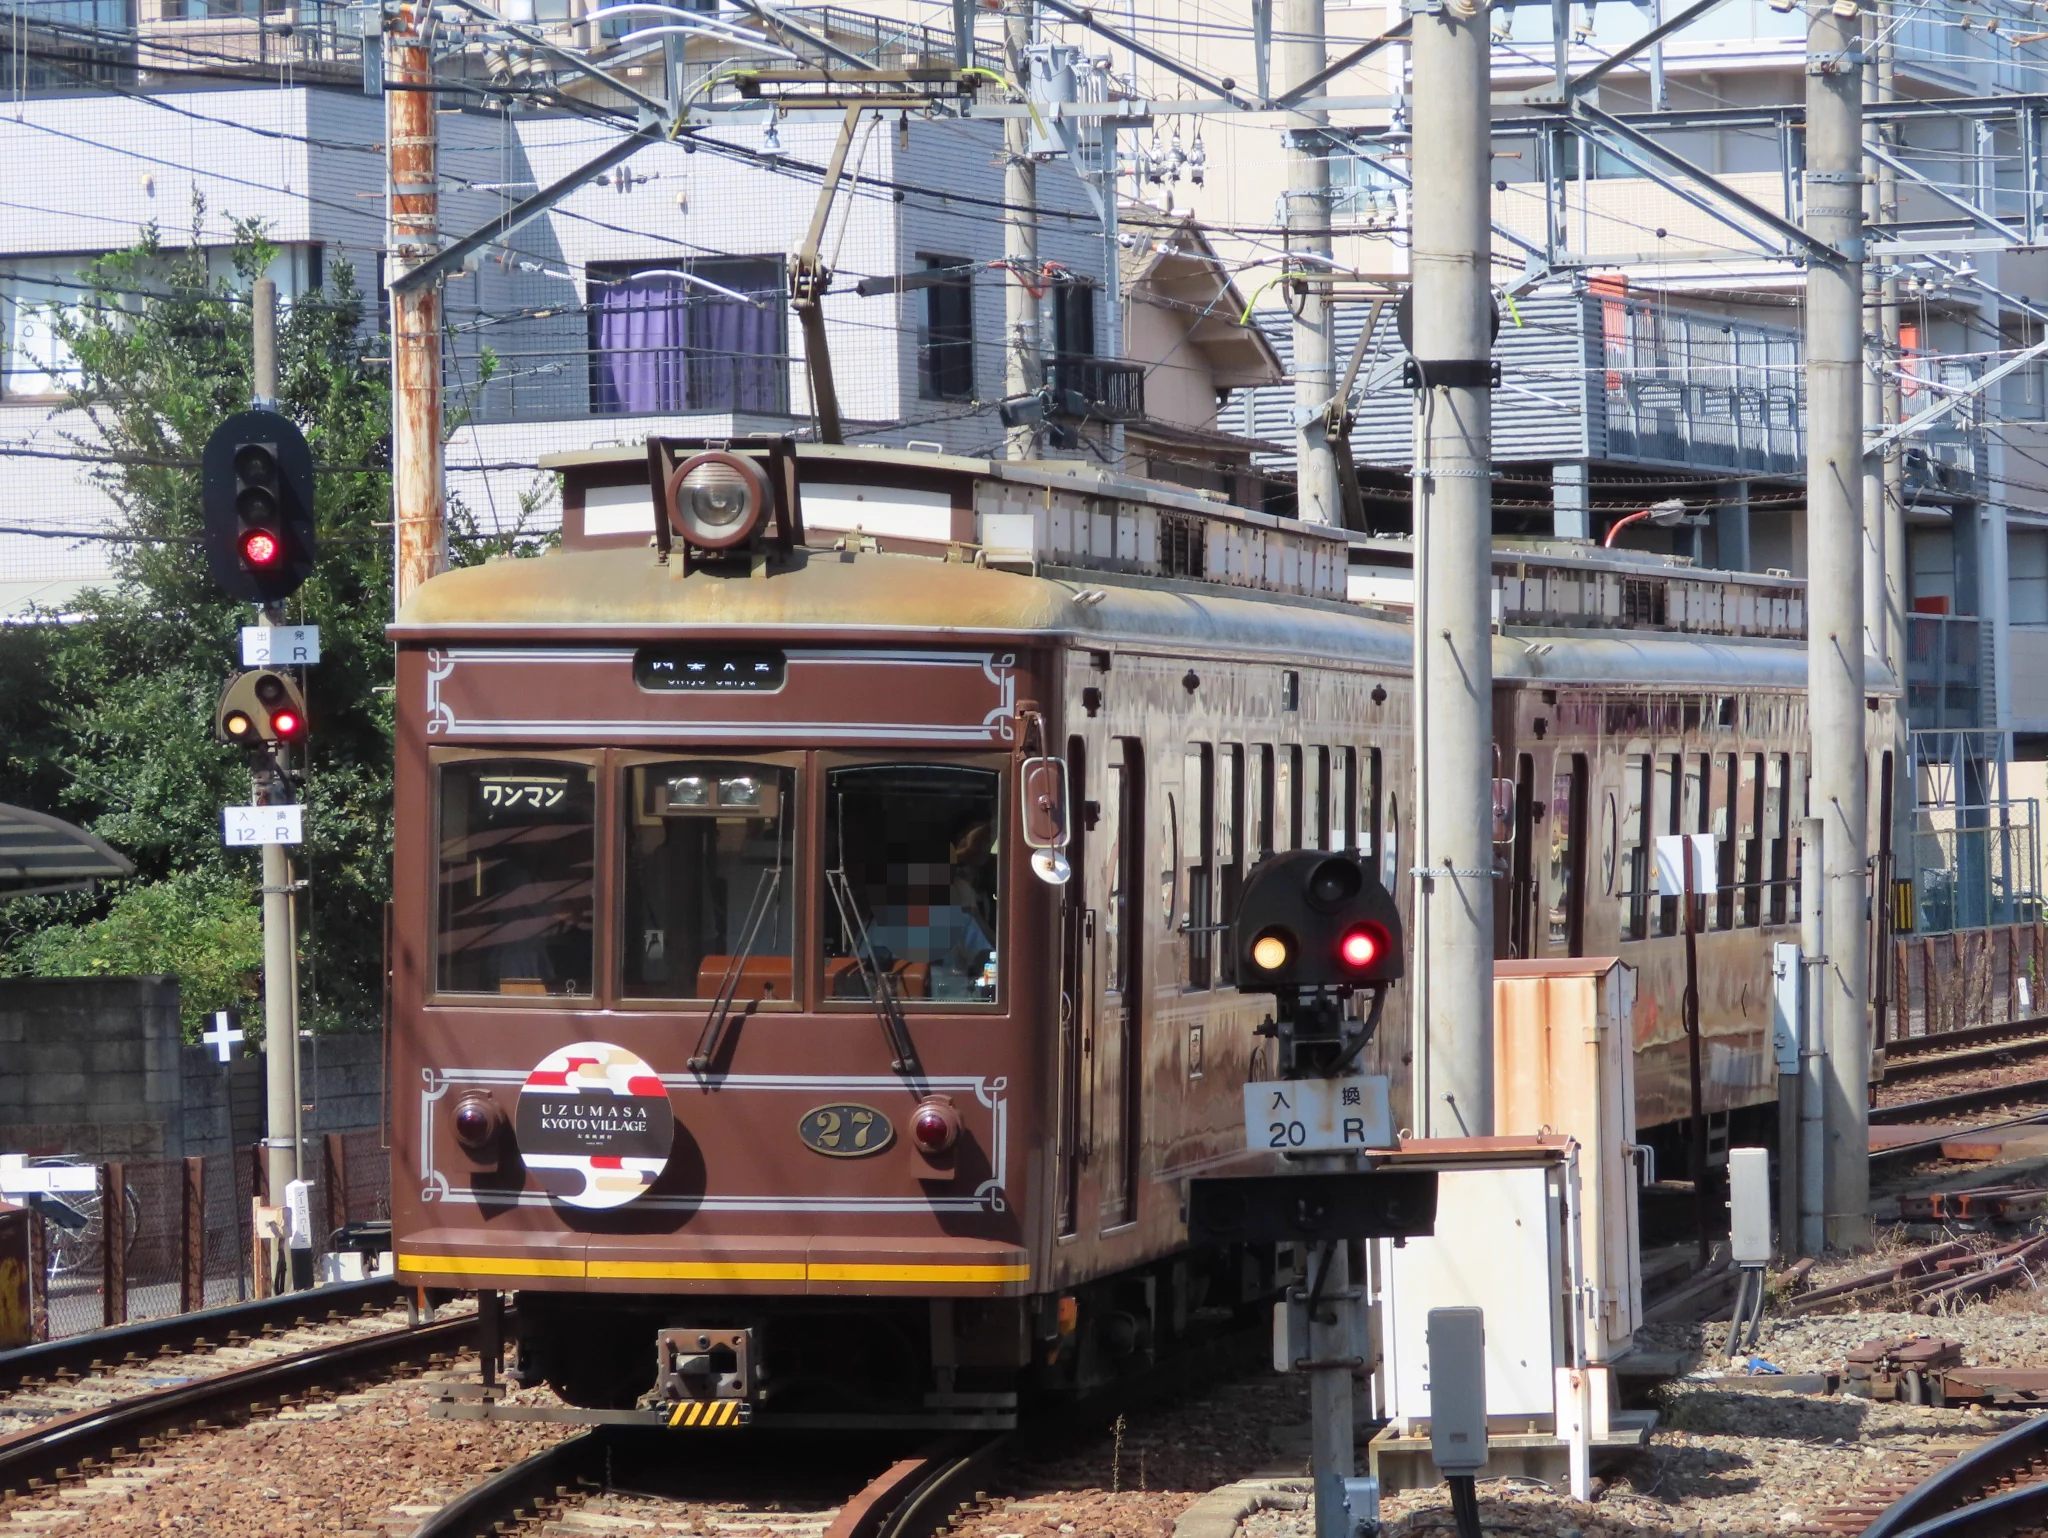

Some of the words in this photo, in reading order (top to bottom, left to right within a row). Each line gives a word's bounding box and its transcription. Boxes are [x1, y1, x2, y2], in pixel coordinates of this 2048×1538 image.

[483, 785, 564, 808] ワンマン
[236, 828, 256, 841] 12
[541, 1104, 647, 1118] UZUMASA
[541, 1118, 588, 1130] KYOTO
[590, 1119, 647, 1132] VILLAGE
[816, 1111, 873, 1148] 27
[1269, 1120, 1306, 1147] 20
[1343, 1118, 1365, 1143] R
